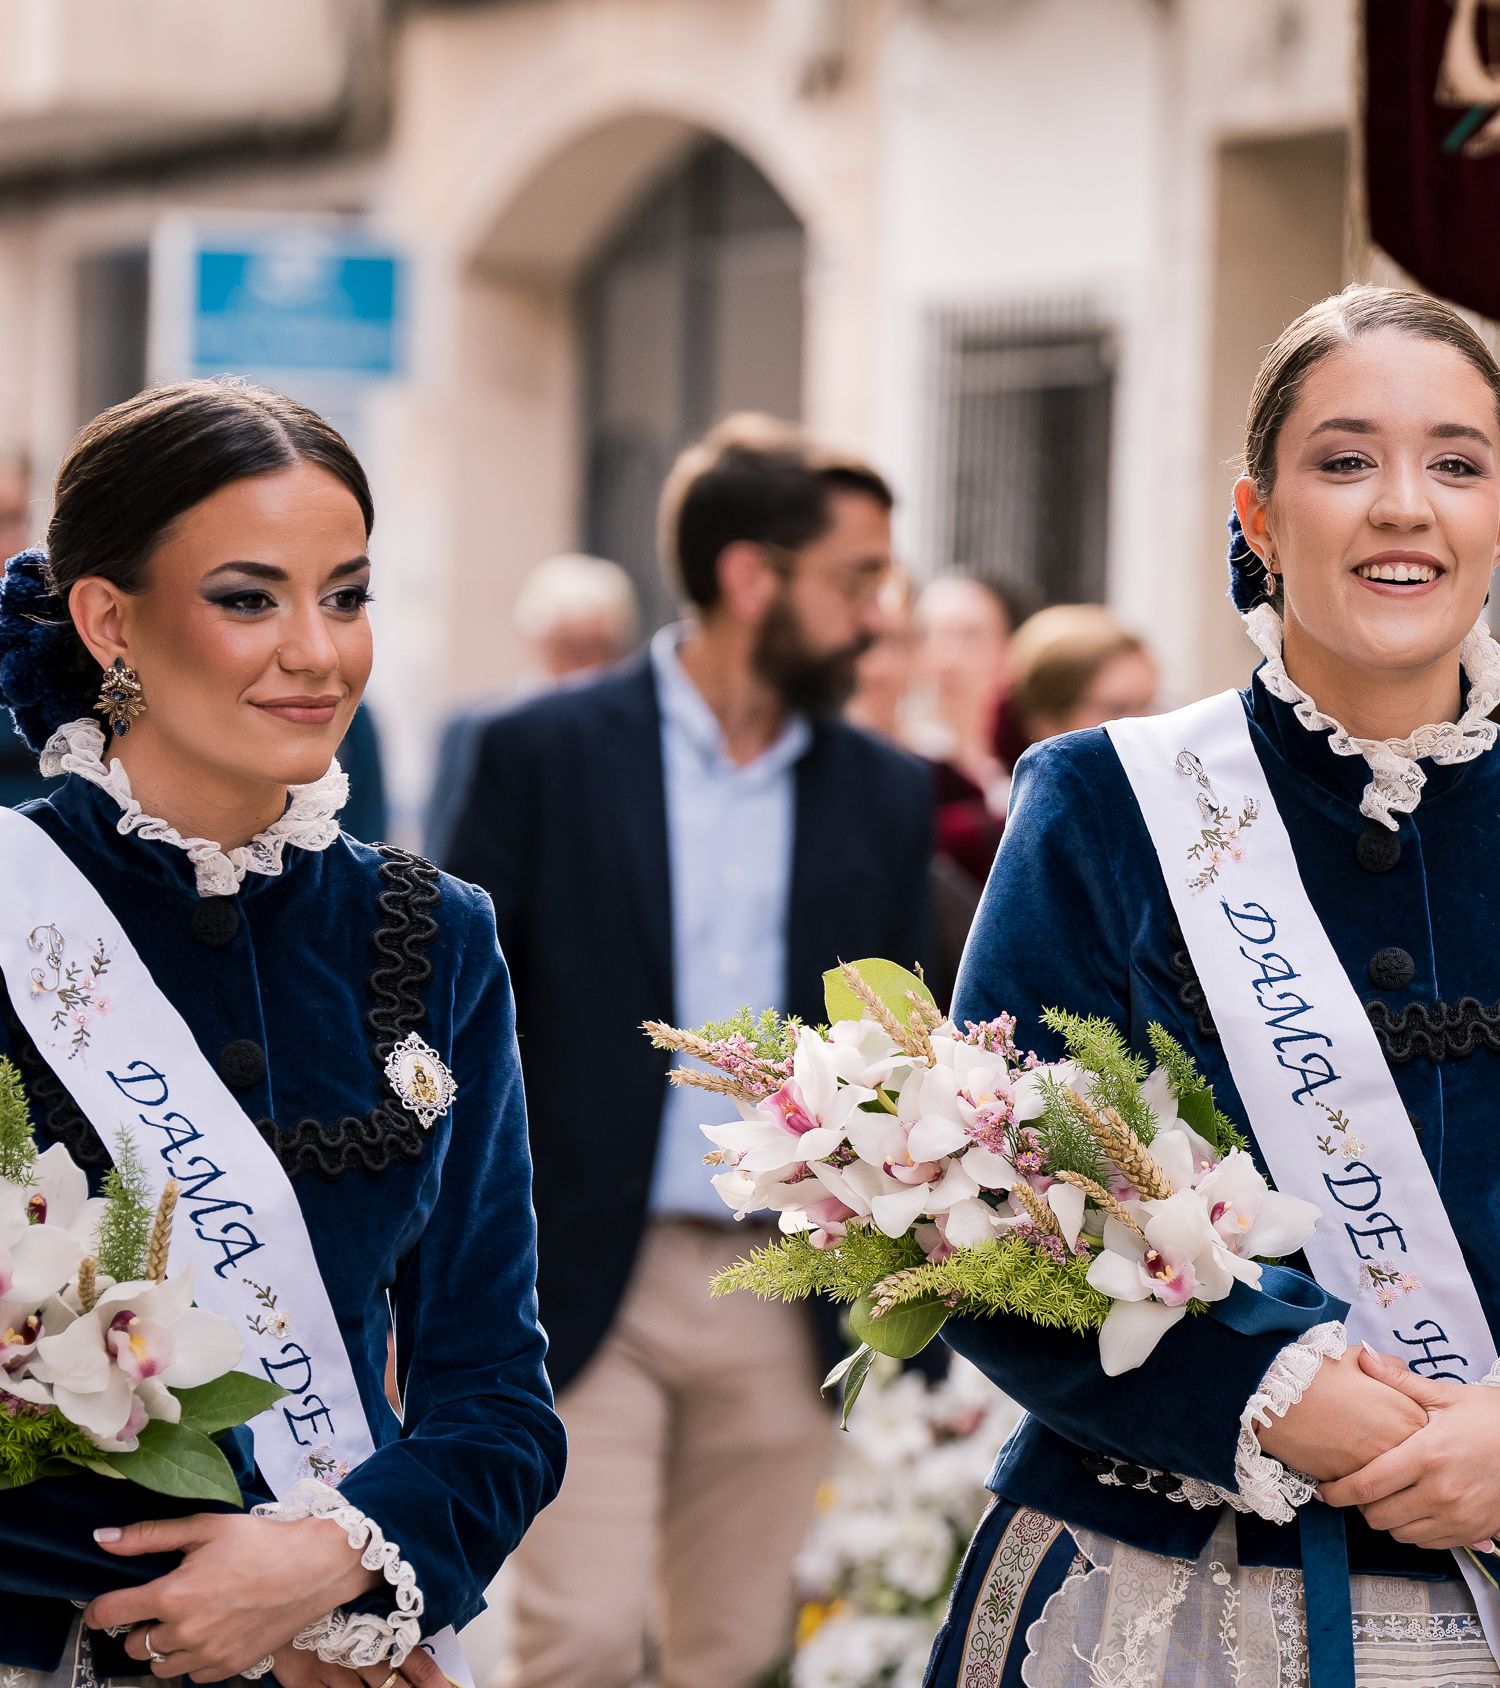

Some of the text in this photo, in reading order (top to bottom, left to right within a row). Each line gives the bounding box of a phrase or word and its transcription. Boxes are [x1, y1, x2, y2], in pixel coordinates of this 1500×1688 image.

[106, 1060, 335, 1447] DAMA DE
[1221, 901, 1469, 1385] DAMA DE H
